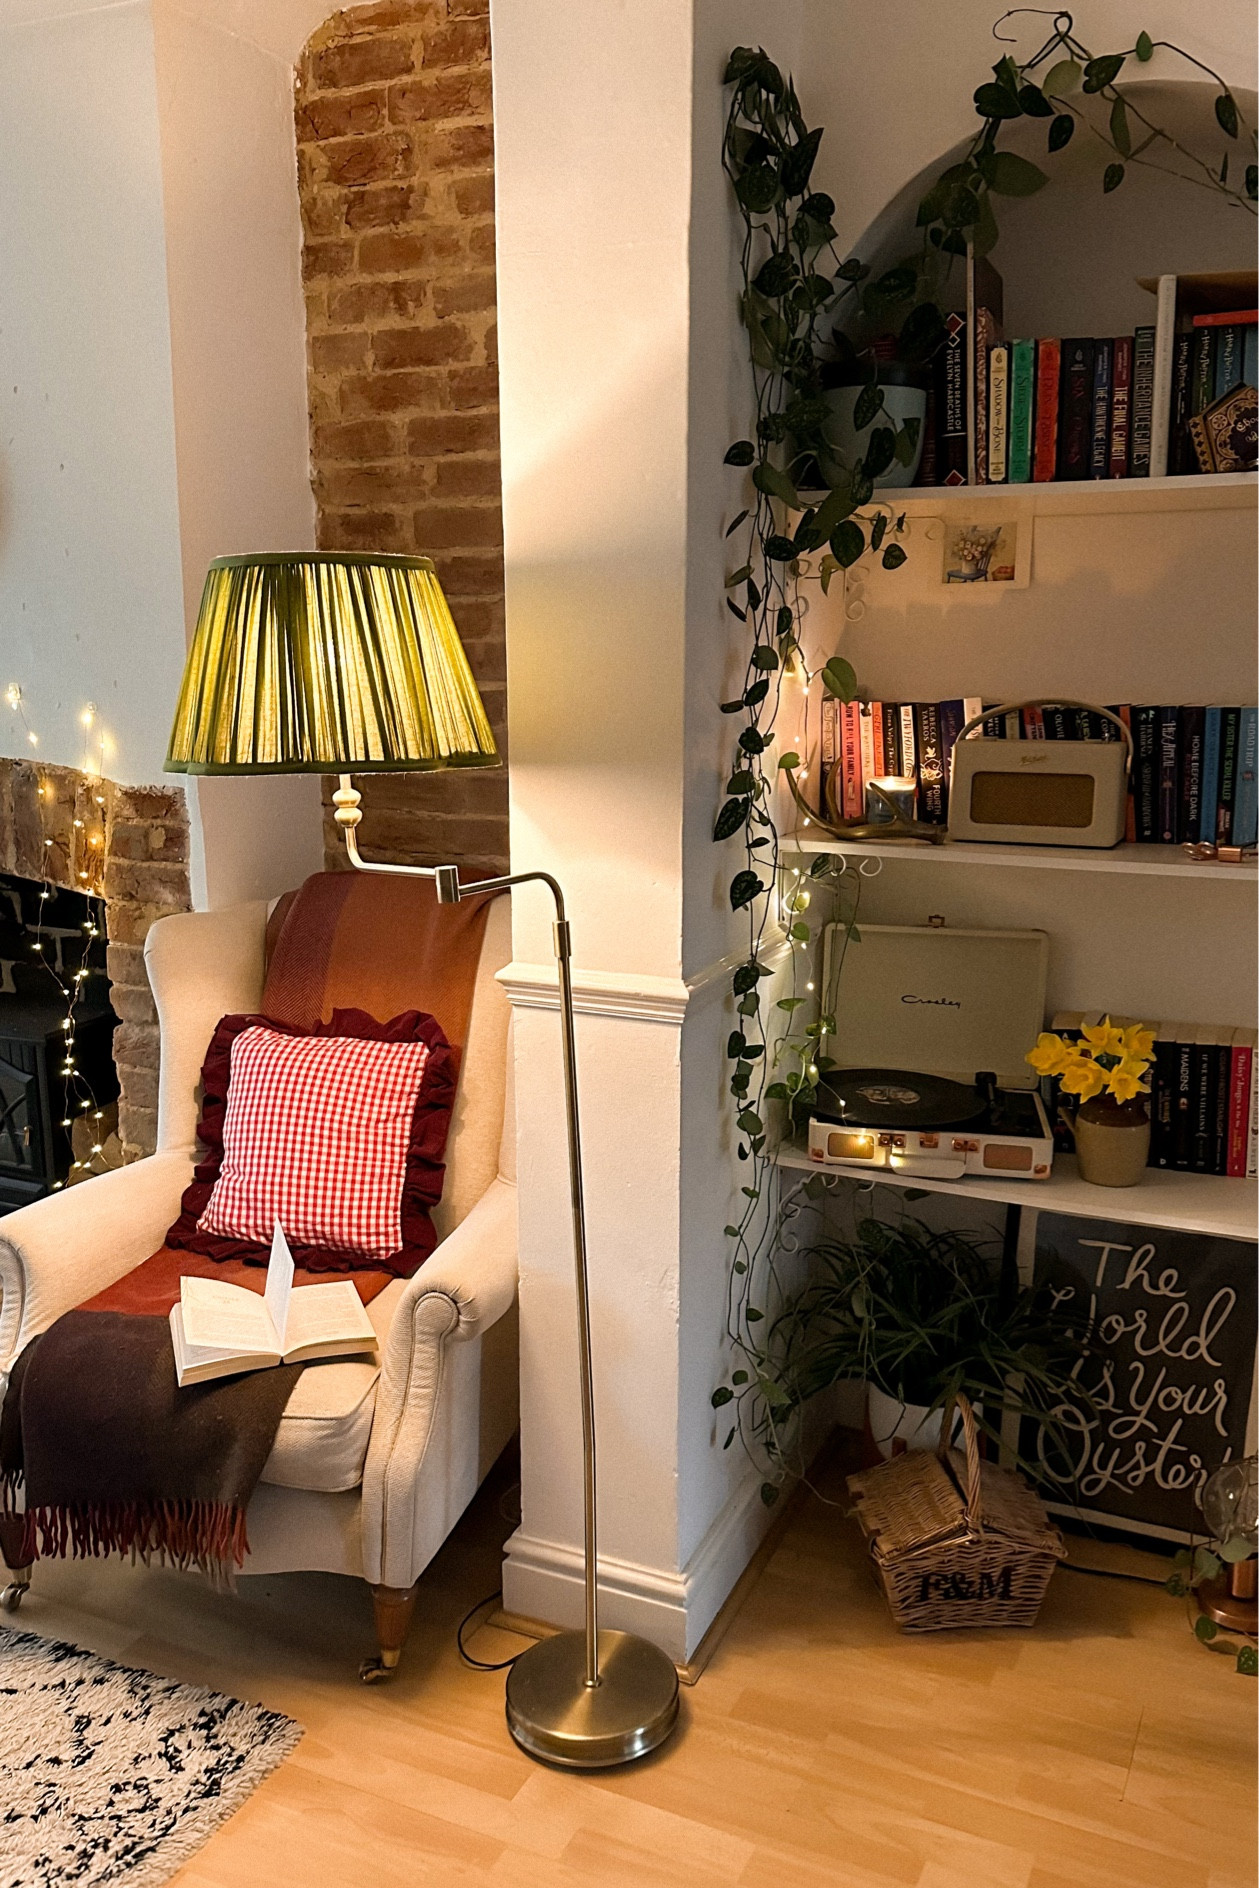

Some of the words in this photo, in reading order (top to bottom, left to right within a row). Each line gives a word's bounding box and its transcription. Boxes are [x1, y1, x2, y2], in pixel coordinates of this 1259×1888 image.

[953, 349, 961, 363] THE
[1136, 347, 1153, 366] THE
[1178, 342, 1189, 363] HARRY
[1200, 335, 1211, 358] HARRY
[1223, 333, 1235, 356] HARRY
[945, 350, 954, 381] EVELYN
[953, 364, 961, 388] SEVEN
[1178, 364, 1189, 388] POTTER
[1200, 358, 1211, 383] POTTER
[1223, 356, 1235, 381] POTTER
[993, 377, 1004, 417] SHADOW
[1016, 375, 1029, 404] SIEGE
[1095, 386, 1108, 398] THE
[1113, 386, 1128, 402] THE
[1134, 368, 1153, 429] INHERITANCE
[946, 383, 955, 431] HARDCASTLE
[953, 390, 962, 414] DEATHS
[954, 419, 962, 430] OF
[1113, 404, 1127, 429] FINAL
[993, 426, 1004, 454] BONE
[1014, 415, 1027, 452] STORM
[1111, 431, 1126, 460] GAMBIT
[1093, 441, 1107, 467] LEGACY
[1133, 431, 1151, 465] GAMES
[845, 706, 854, 718] HOW
[1227, 713, 1236, 724] MY
[886, 727, 894, 744] Valpy
[922, 710, 930, 741] YARROS
[928, 706, 937, 744] REBECCA
[1055, 714, 1065, 739] OLIVIE
[1226, 725, 1236, 745] SISTER
[1246, 722, 1257, 746] ROAD
[847, 741, 855, 755] YOUR
[902, 718, 913, 757] TWYFORD
[1191, 735, 1200, 760] HOME
[1225, 746, 1234, 759] THE
[1245, 746, 1255, 767] TRIP
[847, 757, 855, 775] FAMILY
[887, 759, 895, 776] Cypr
[1223, 759, 1233, 780] SERIAL
[1190, 762, 1199, 796] BEFORE
[1222, 780, 1232, 801] KILLER
[926, 790, 934, 811] WING
[932, 784, 942, 814] FOURTH
[1189, 797, 1198, 821] DARK
[901, 994, 961, 1010] Crosley
[1201, 1053, 1208, 1062] IF
[1201, 1063, 1208, 1074] WE
[1235, 1054, 1247, 1077] Daisy
[1179, 1053, 1189, 1092] MAIDENS
[1200, 1076, 1208, 1096] WERE
[1199, 1097, 1208, 1131] VILLAINS
[1078, 1238, 1188, 1298] The
[1108, 1361, 1229, 1439] Your
[919, 1566, 1013, 1601] F&M
